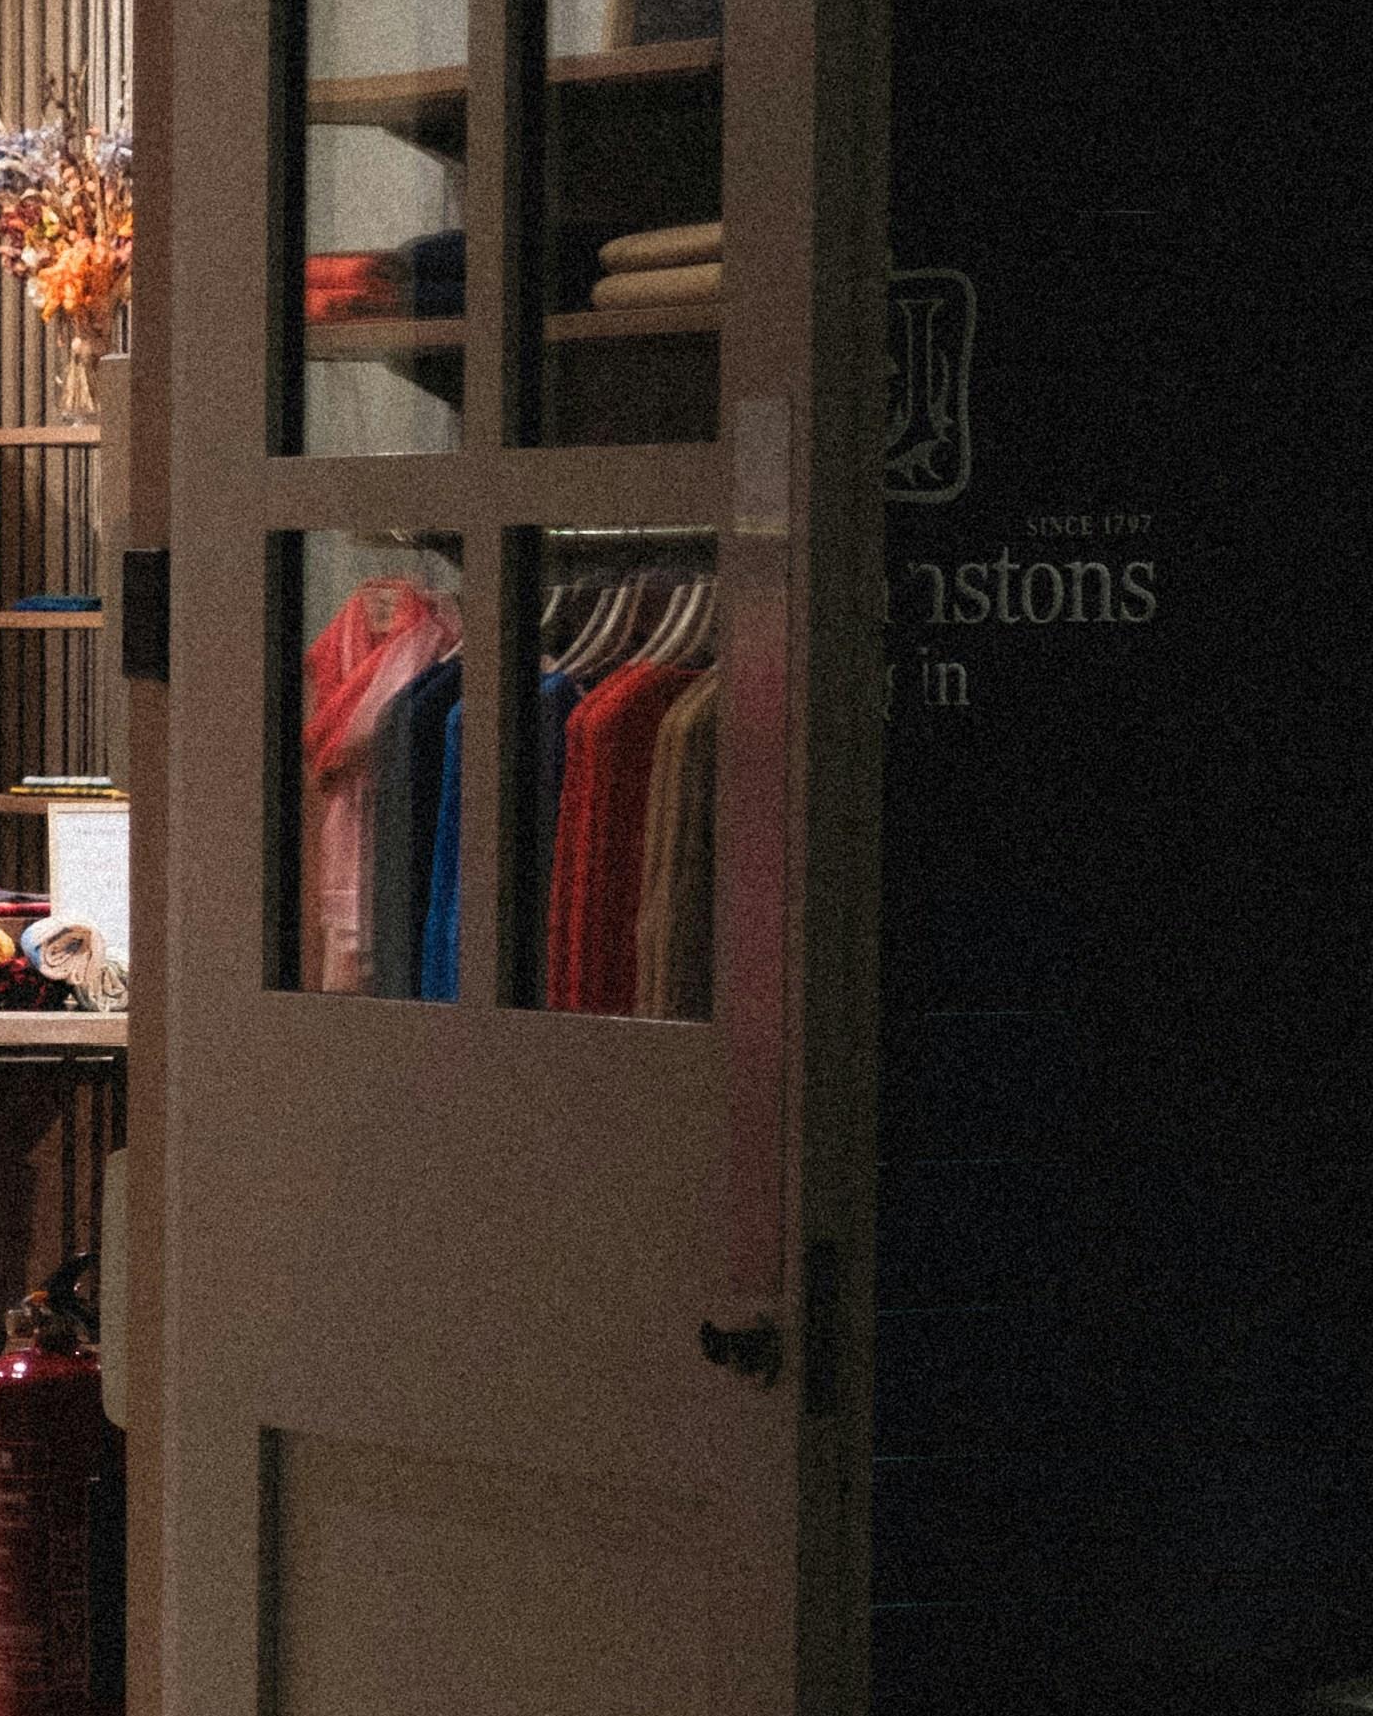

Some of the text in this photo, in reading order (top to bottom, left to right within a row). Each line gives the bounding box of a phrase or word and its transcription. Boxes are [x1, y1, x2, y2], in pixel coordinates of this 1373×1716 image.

[1026, 512, 1153, 537] SINCE 1797
[885, 545, 1157, 624] nstons
